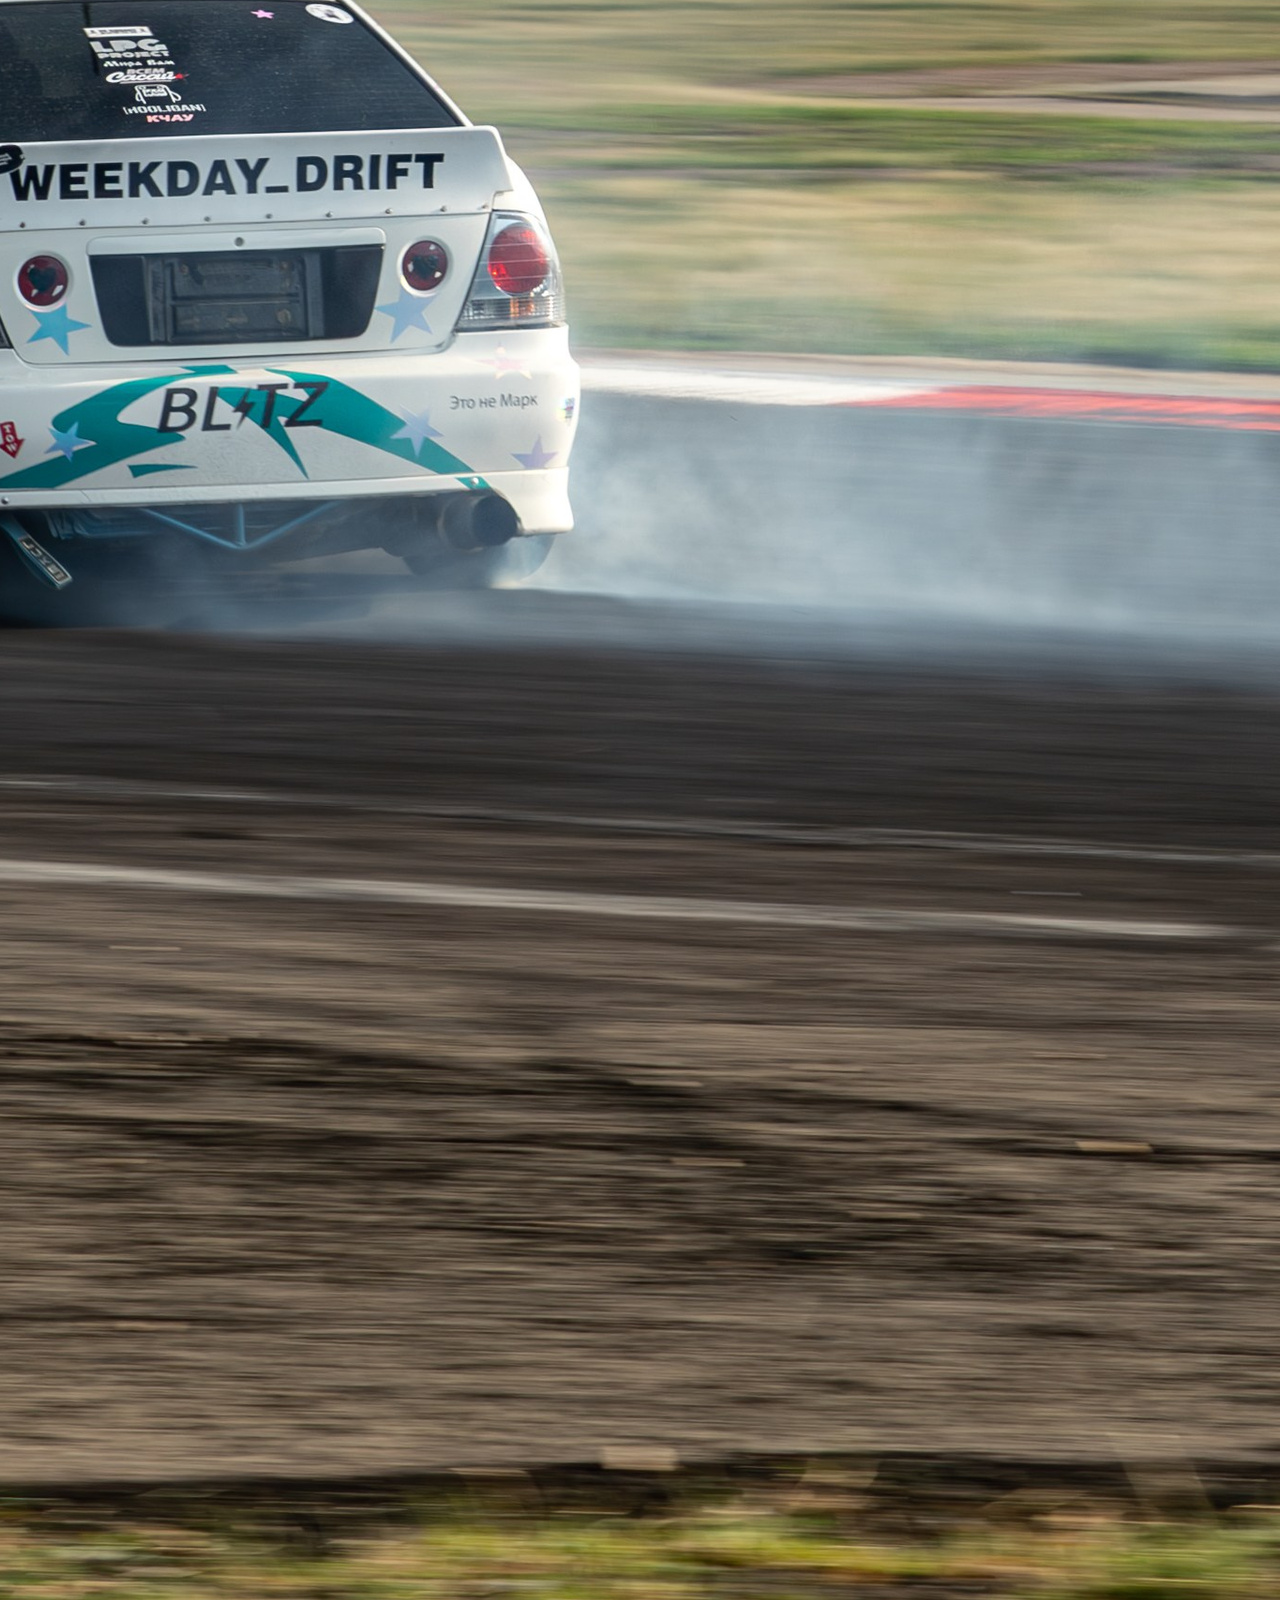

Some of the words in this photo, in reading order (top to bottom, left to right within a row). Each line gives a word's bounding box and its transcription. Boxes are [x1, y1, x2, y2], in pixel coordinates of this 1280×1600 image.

[89, 38, 168, 53] LPG
[97, 50, 170, 59] PROJECT
[146, 113, 195, 122] КЧАУ
[9, 152, 445, 202] WEEKDAY_DRIFT
[449, 395, 476, 410] Это
[479, 396, 497, 408] не
[500, 393, 539, 409] Марк
